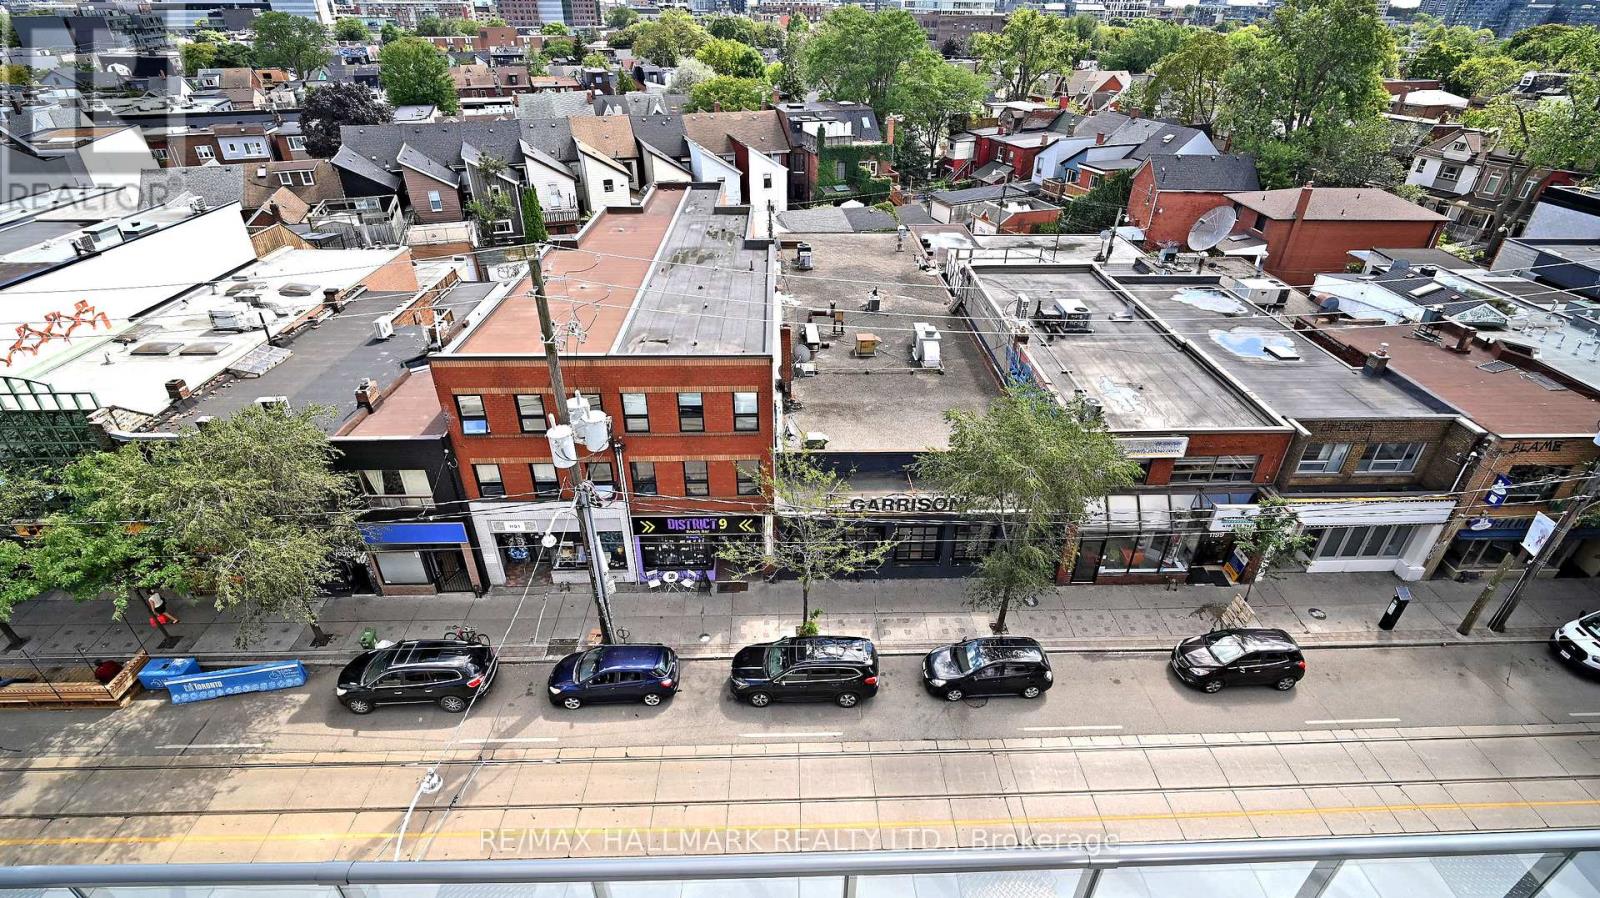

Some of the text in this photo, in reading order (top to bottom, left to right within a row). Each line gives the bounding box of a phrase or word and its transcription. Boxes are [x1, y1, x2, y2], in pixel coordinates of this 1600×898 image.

[1509, 440, 1563, 454] BLAME
[667, 518, 728, 530] DISTRICT 9
[194, 681, 223, 691] TORONTO
